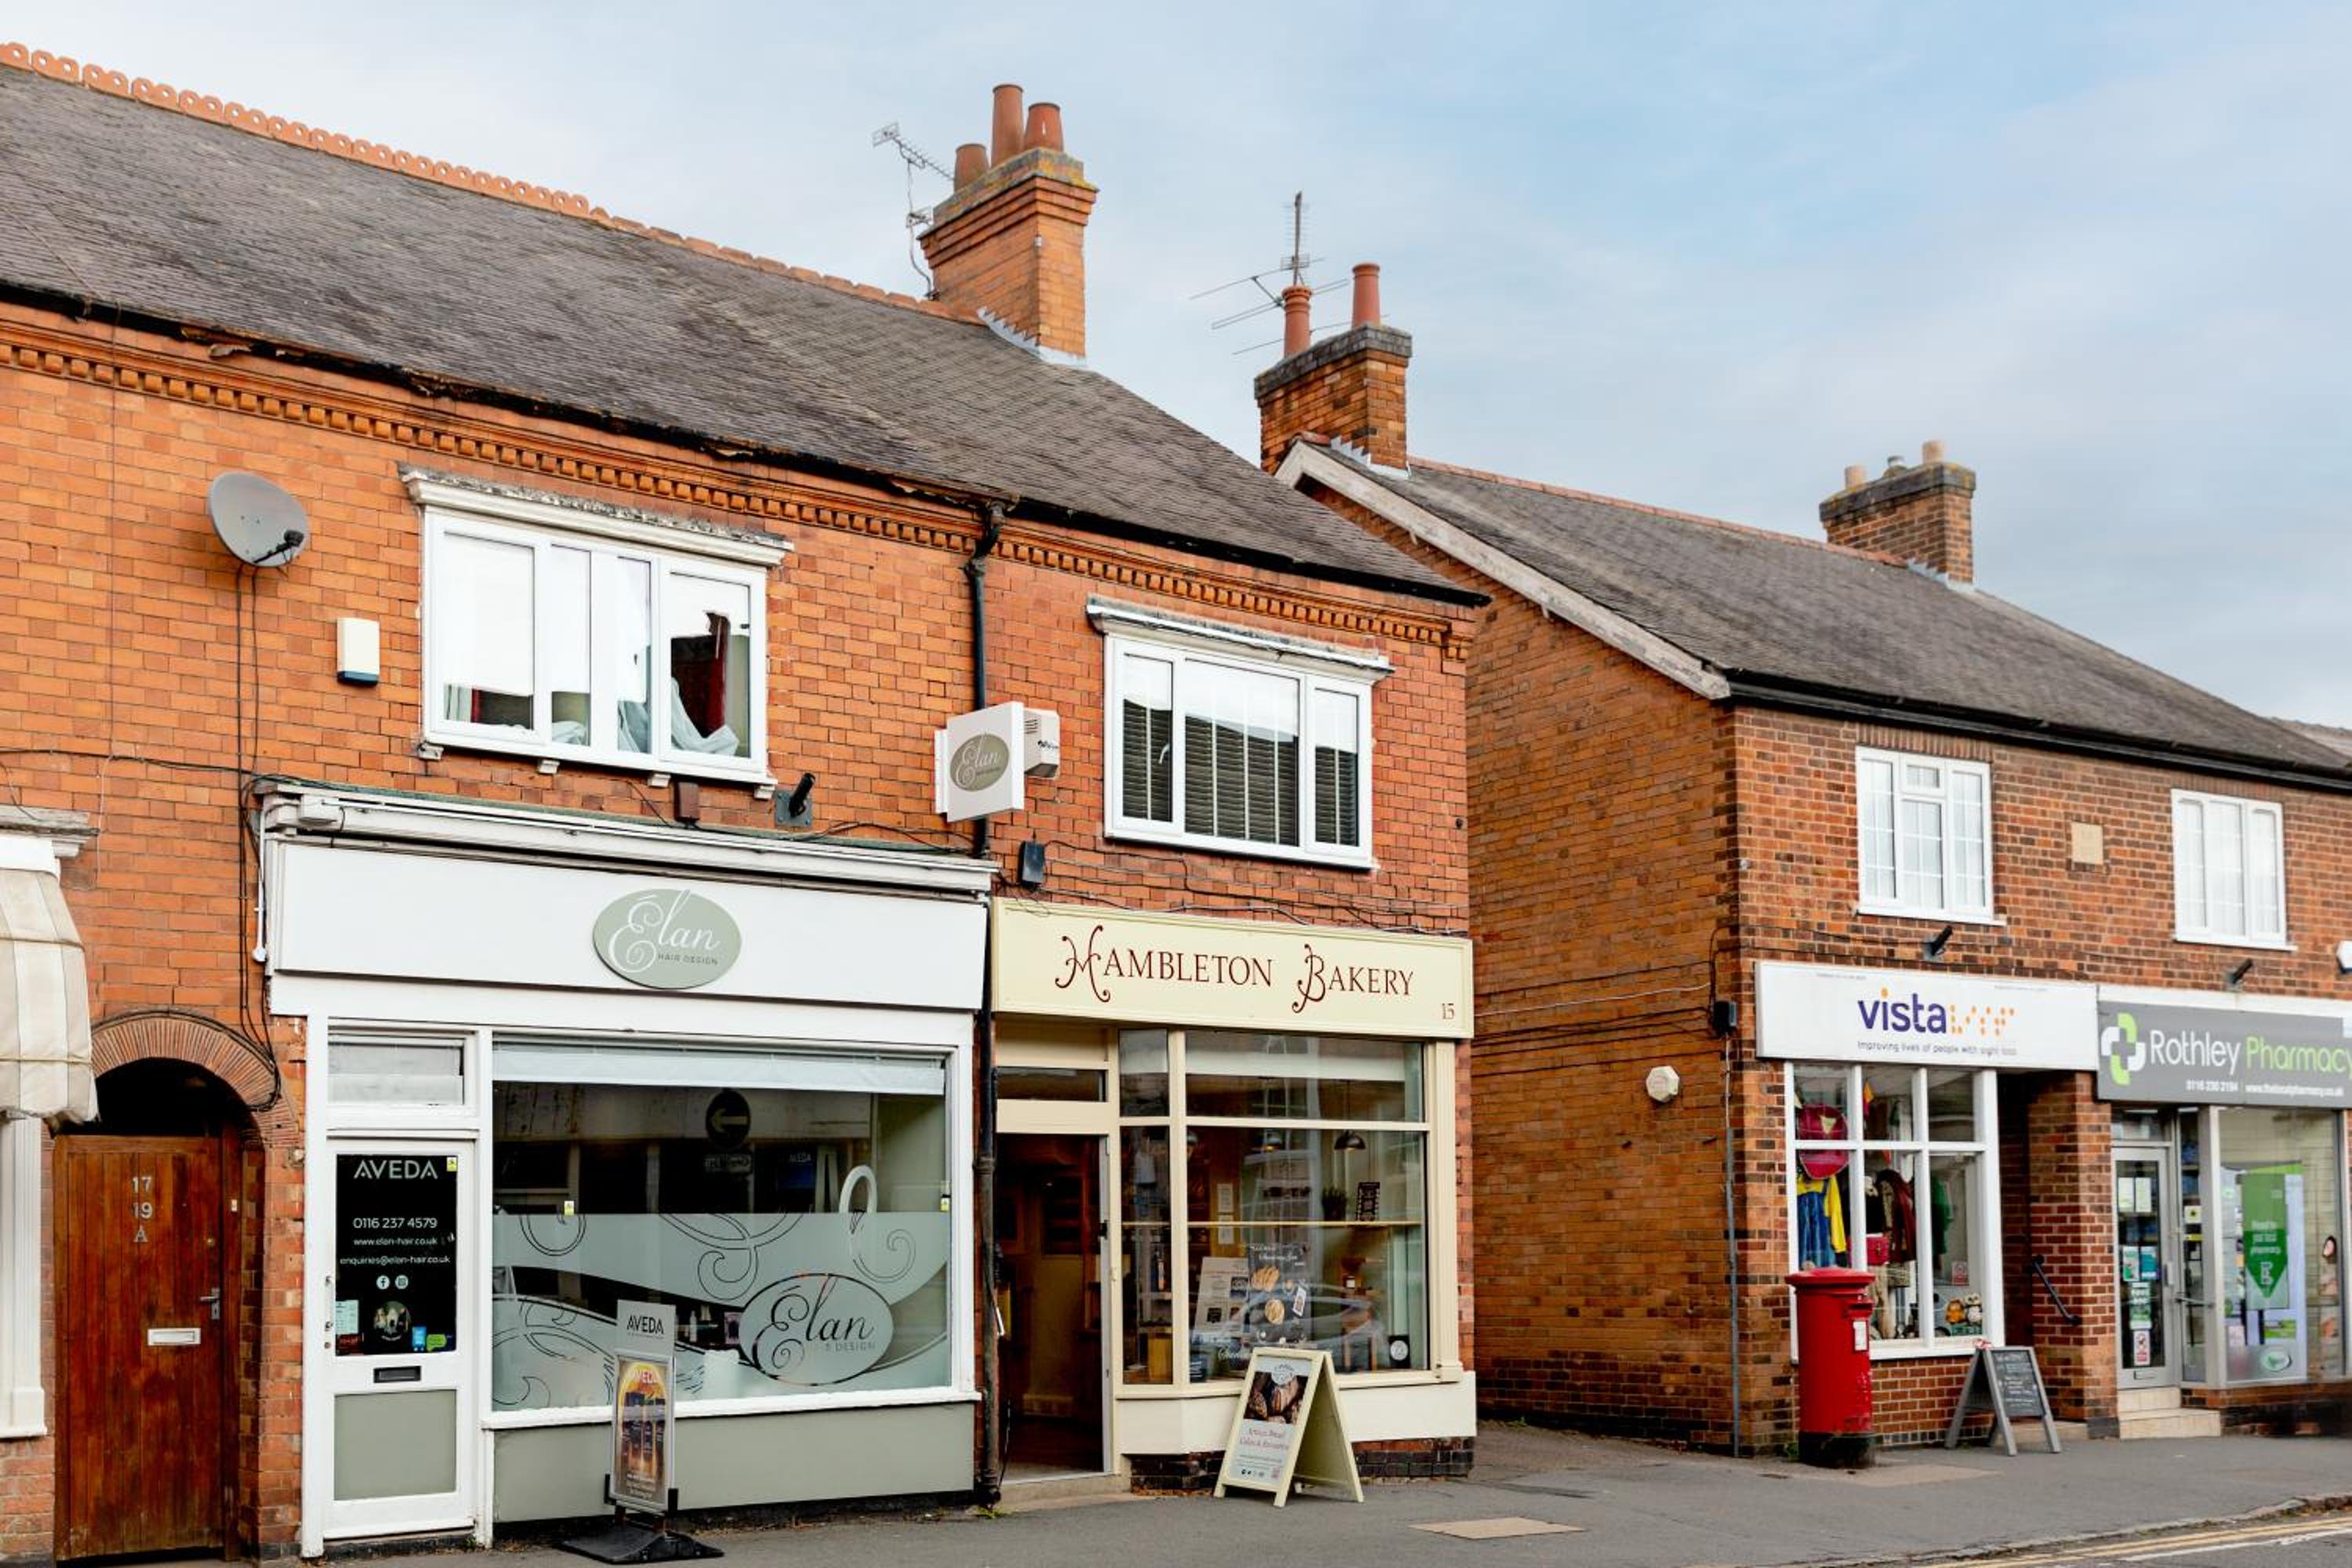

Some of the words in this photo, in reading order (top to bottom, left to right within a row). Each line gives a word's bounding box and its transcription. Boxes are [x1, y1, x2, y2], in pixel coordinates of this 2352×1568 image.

[658, 953, 681, 962] HAIR
[683, 955, 718, 966] DESIGN
[1054, 925, 1273, 1003] HAMBLETON
[1291, 943, 1414, 1013] BAKERY
[1441, 1003, 1455, 1020] 15
[1857, 988, 1947, 1034] vista
[1857, 1040, 1900, 1053] Improving
[2150, 1029, 2241, 1076] Rothley
[354, 1160, 438, 1179] AVEDA
[132, 1176, 152, 1193] 17
[132, 1201, 153, 1219] 19
[353, 1218, 380, 1229] 0116
[382, 1218, 405, 1229] 237
[407, 1218, 438, 1229] 4579
[133, 1224, 148, 1243] A
[353, 1236, 437, 1246] www.elan-hair.co.uk
[339, 1255, 451, 1266] enquiries@elan-hair.co.uk
[627, 1315, 665, 1334] AVEDA
[836, 1341, 877, 1353] DESIGN
